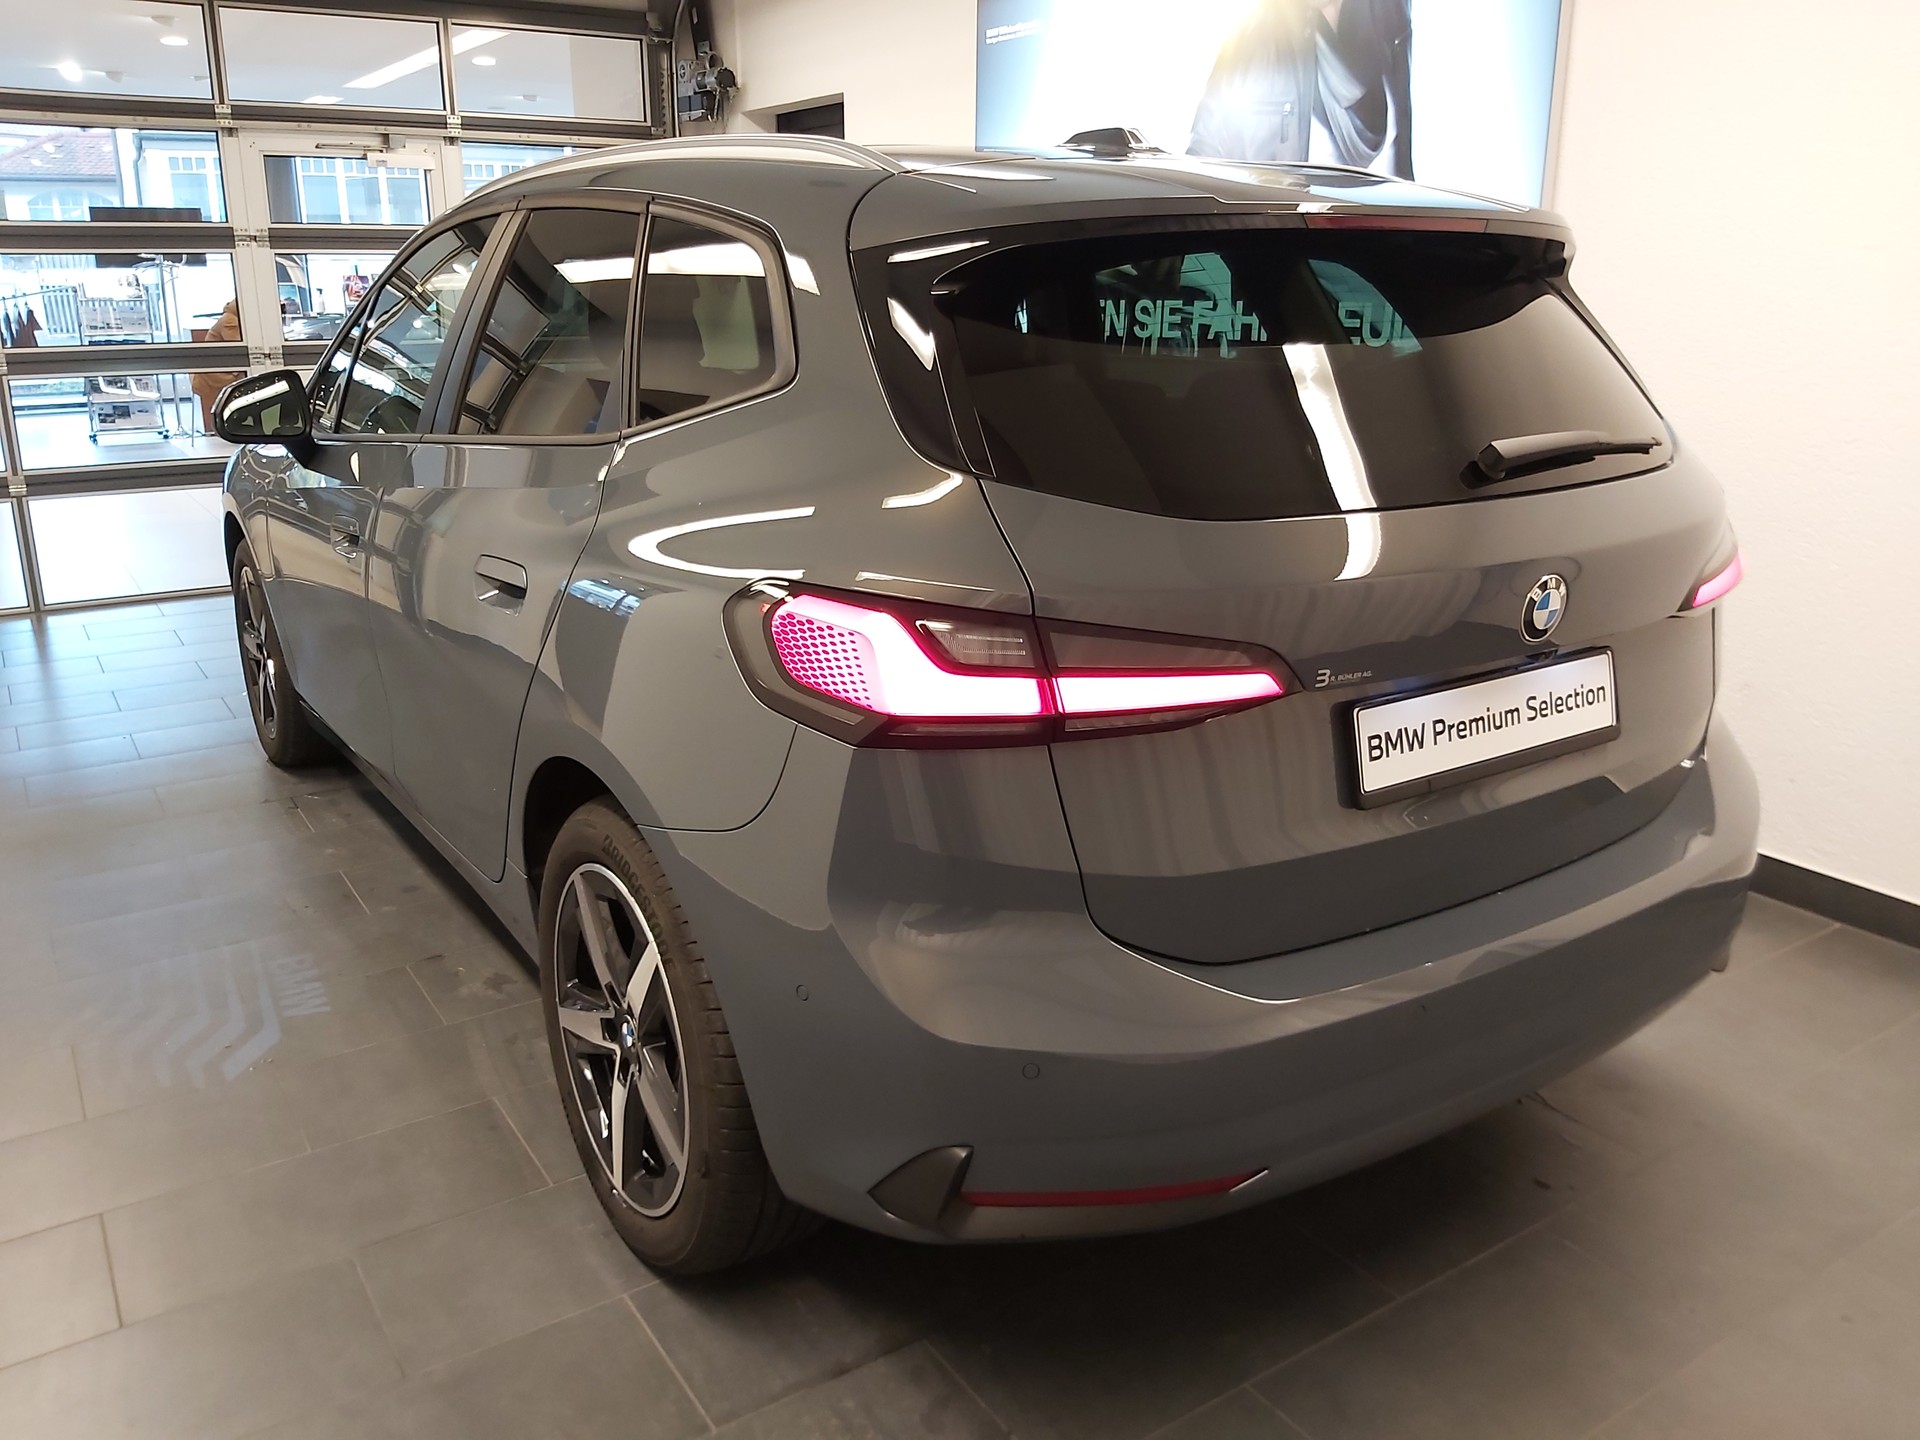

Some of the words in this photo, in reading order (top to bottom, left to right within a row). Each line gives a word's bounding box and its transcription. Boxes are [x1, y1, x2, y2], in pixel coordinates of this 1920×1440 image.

[1133, 299, 1183, 339] SIE
[1366, 722, 1426, 763] BMW
[1432, 703, 1522, 746] Premium
[1525, 683, 1607, 722] Selection
